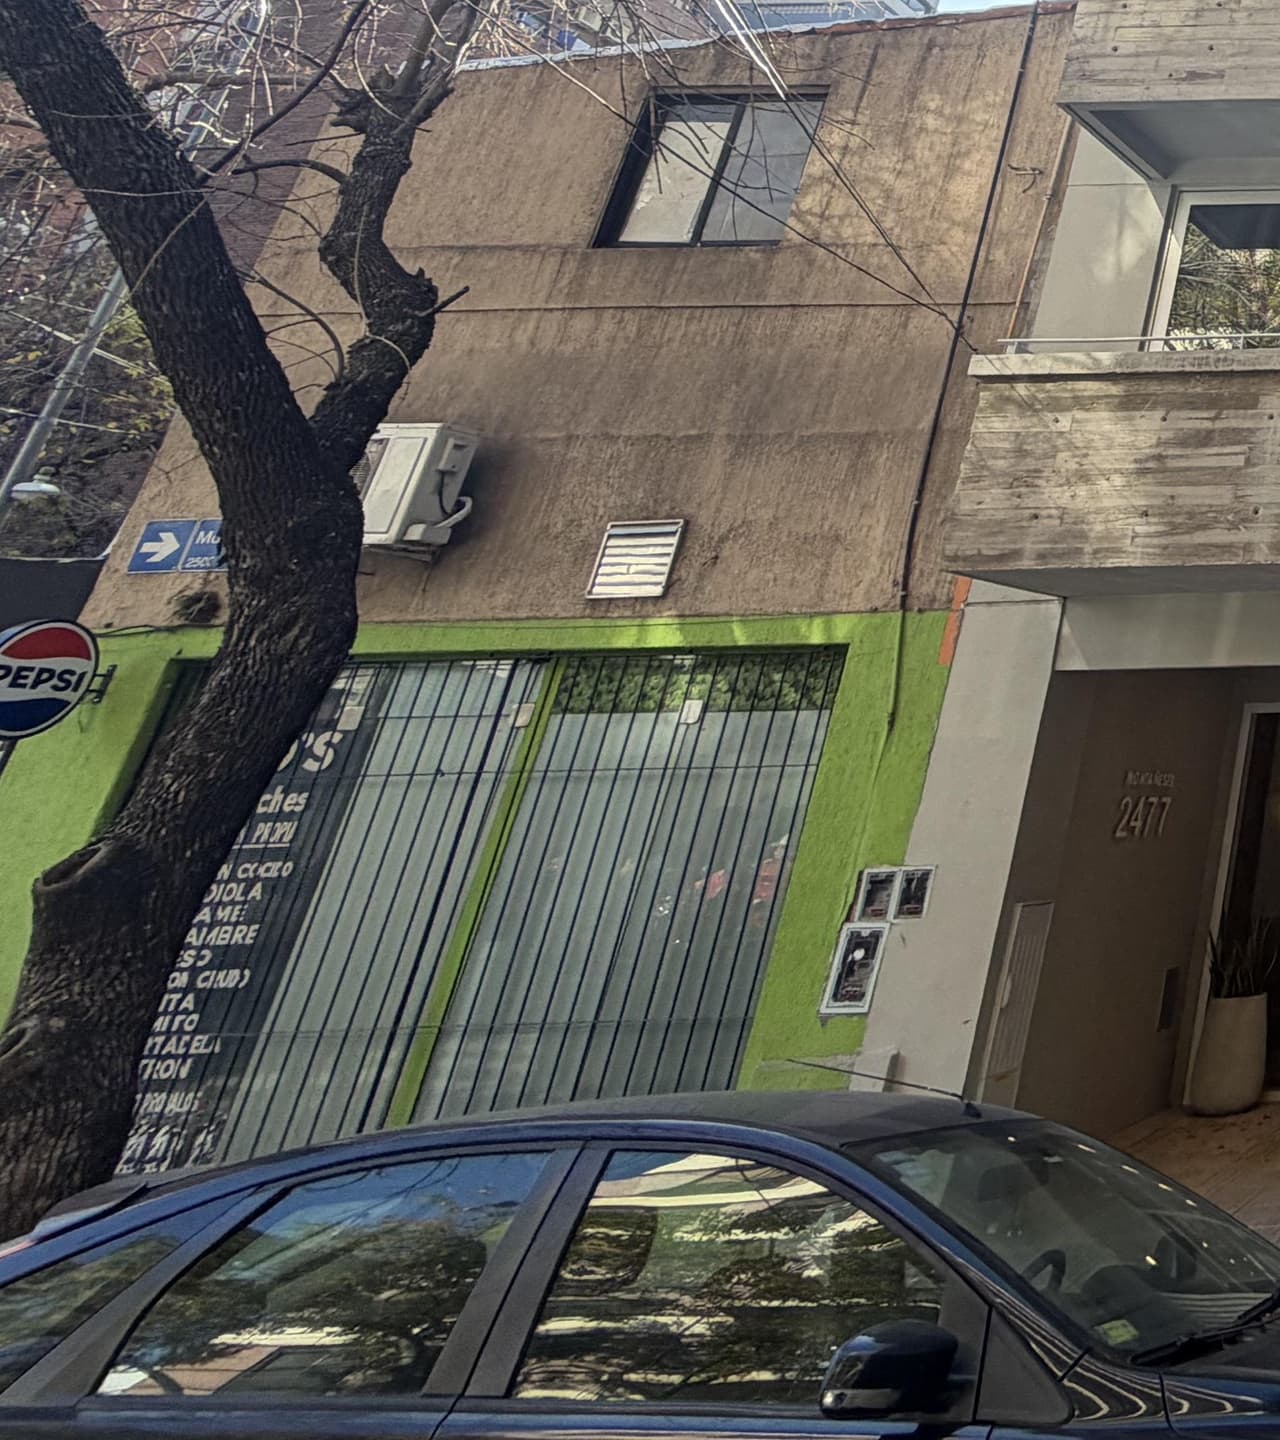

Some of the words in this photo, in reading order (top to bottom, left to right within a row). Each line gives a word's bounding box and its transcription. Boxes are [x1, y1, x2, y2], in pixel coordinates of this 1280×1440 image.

[256, 785, 309, 814] ches
[1115, 796, 1172, 839] 2477
[184, 924, 261, 946] AMBRE
[158, 993, 194, 1012] ITA
